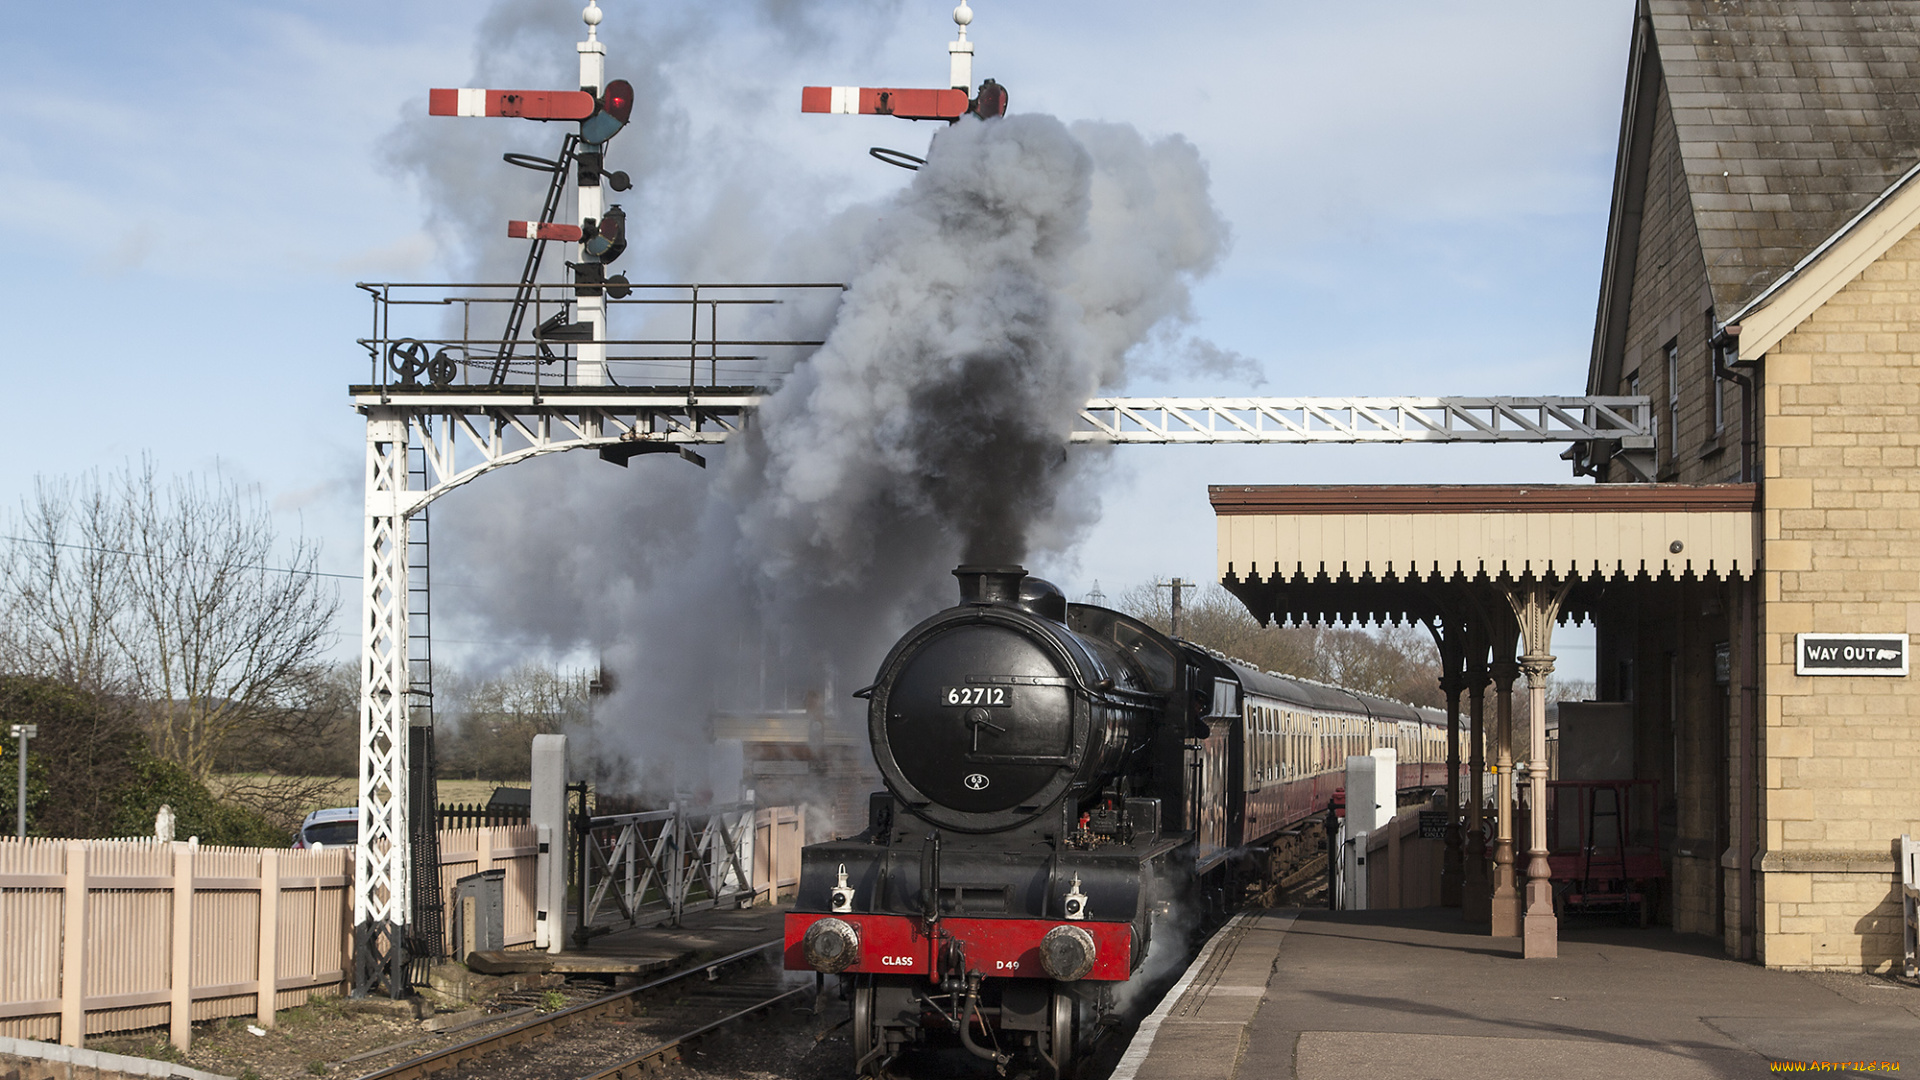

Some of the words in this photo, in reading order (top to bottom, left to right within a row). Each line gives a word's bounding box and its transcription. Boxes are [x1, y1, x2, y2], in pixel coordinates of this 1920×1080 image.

[1807, 645, 1838, 661] WAY
[1844, 645, 1876, 661] OUT
[948, 687, 1004, 705] 62712
[971, 775, 982, 784] 63
[882, 956, 913, 966] CLASS
